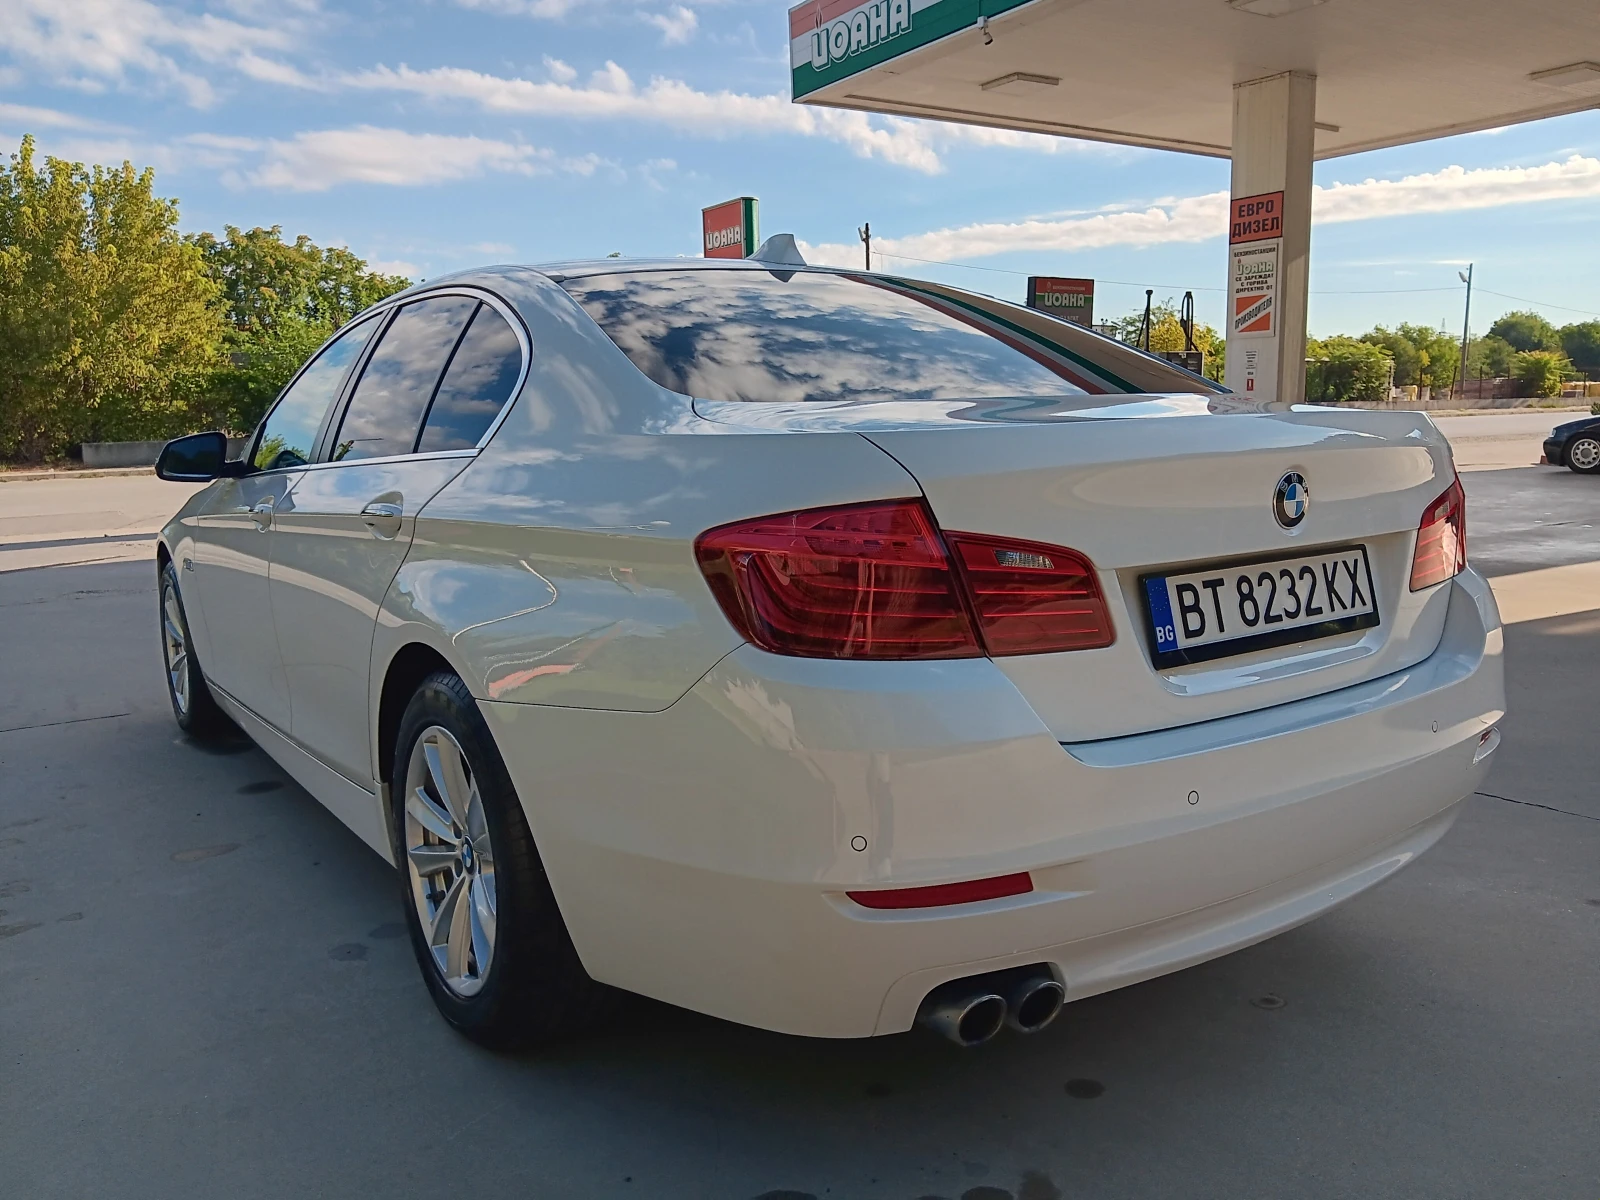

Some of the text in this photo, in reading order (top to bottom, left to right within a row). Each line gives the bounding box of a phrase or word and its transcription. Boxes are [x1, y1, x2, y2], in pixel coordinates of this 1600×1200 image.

[1238, 199, 1274, 218] ЕВРО
[1232, 216, 1280, 238] ДИЗЕЛ
[1244, 273, 1274, 281] ЗАРЕЖДАТ
[1246, 279, 1268, 287] ГОРИВА
[1235, 285, 1264, 294] ДИРЕКТНО
[1175, 577, 1226, 640] BT
[1155, 625, 1174, 644] BG
